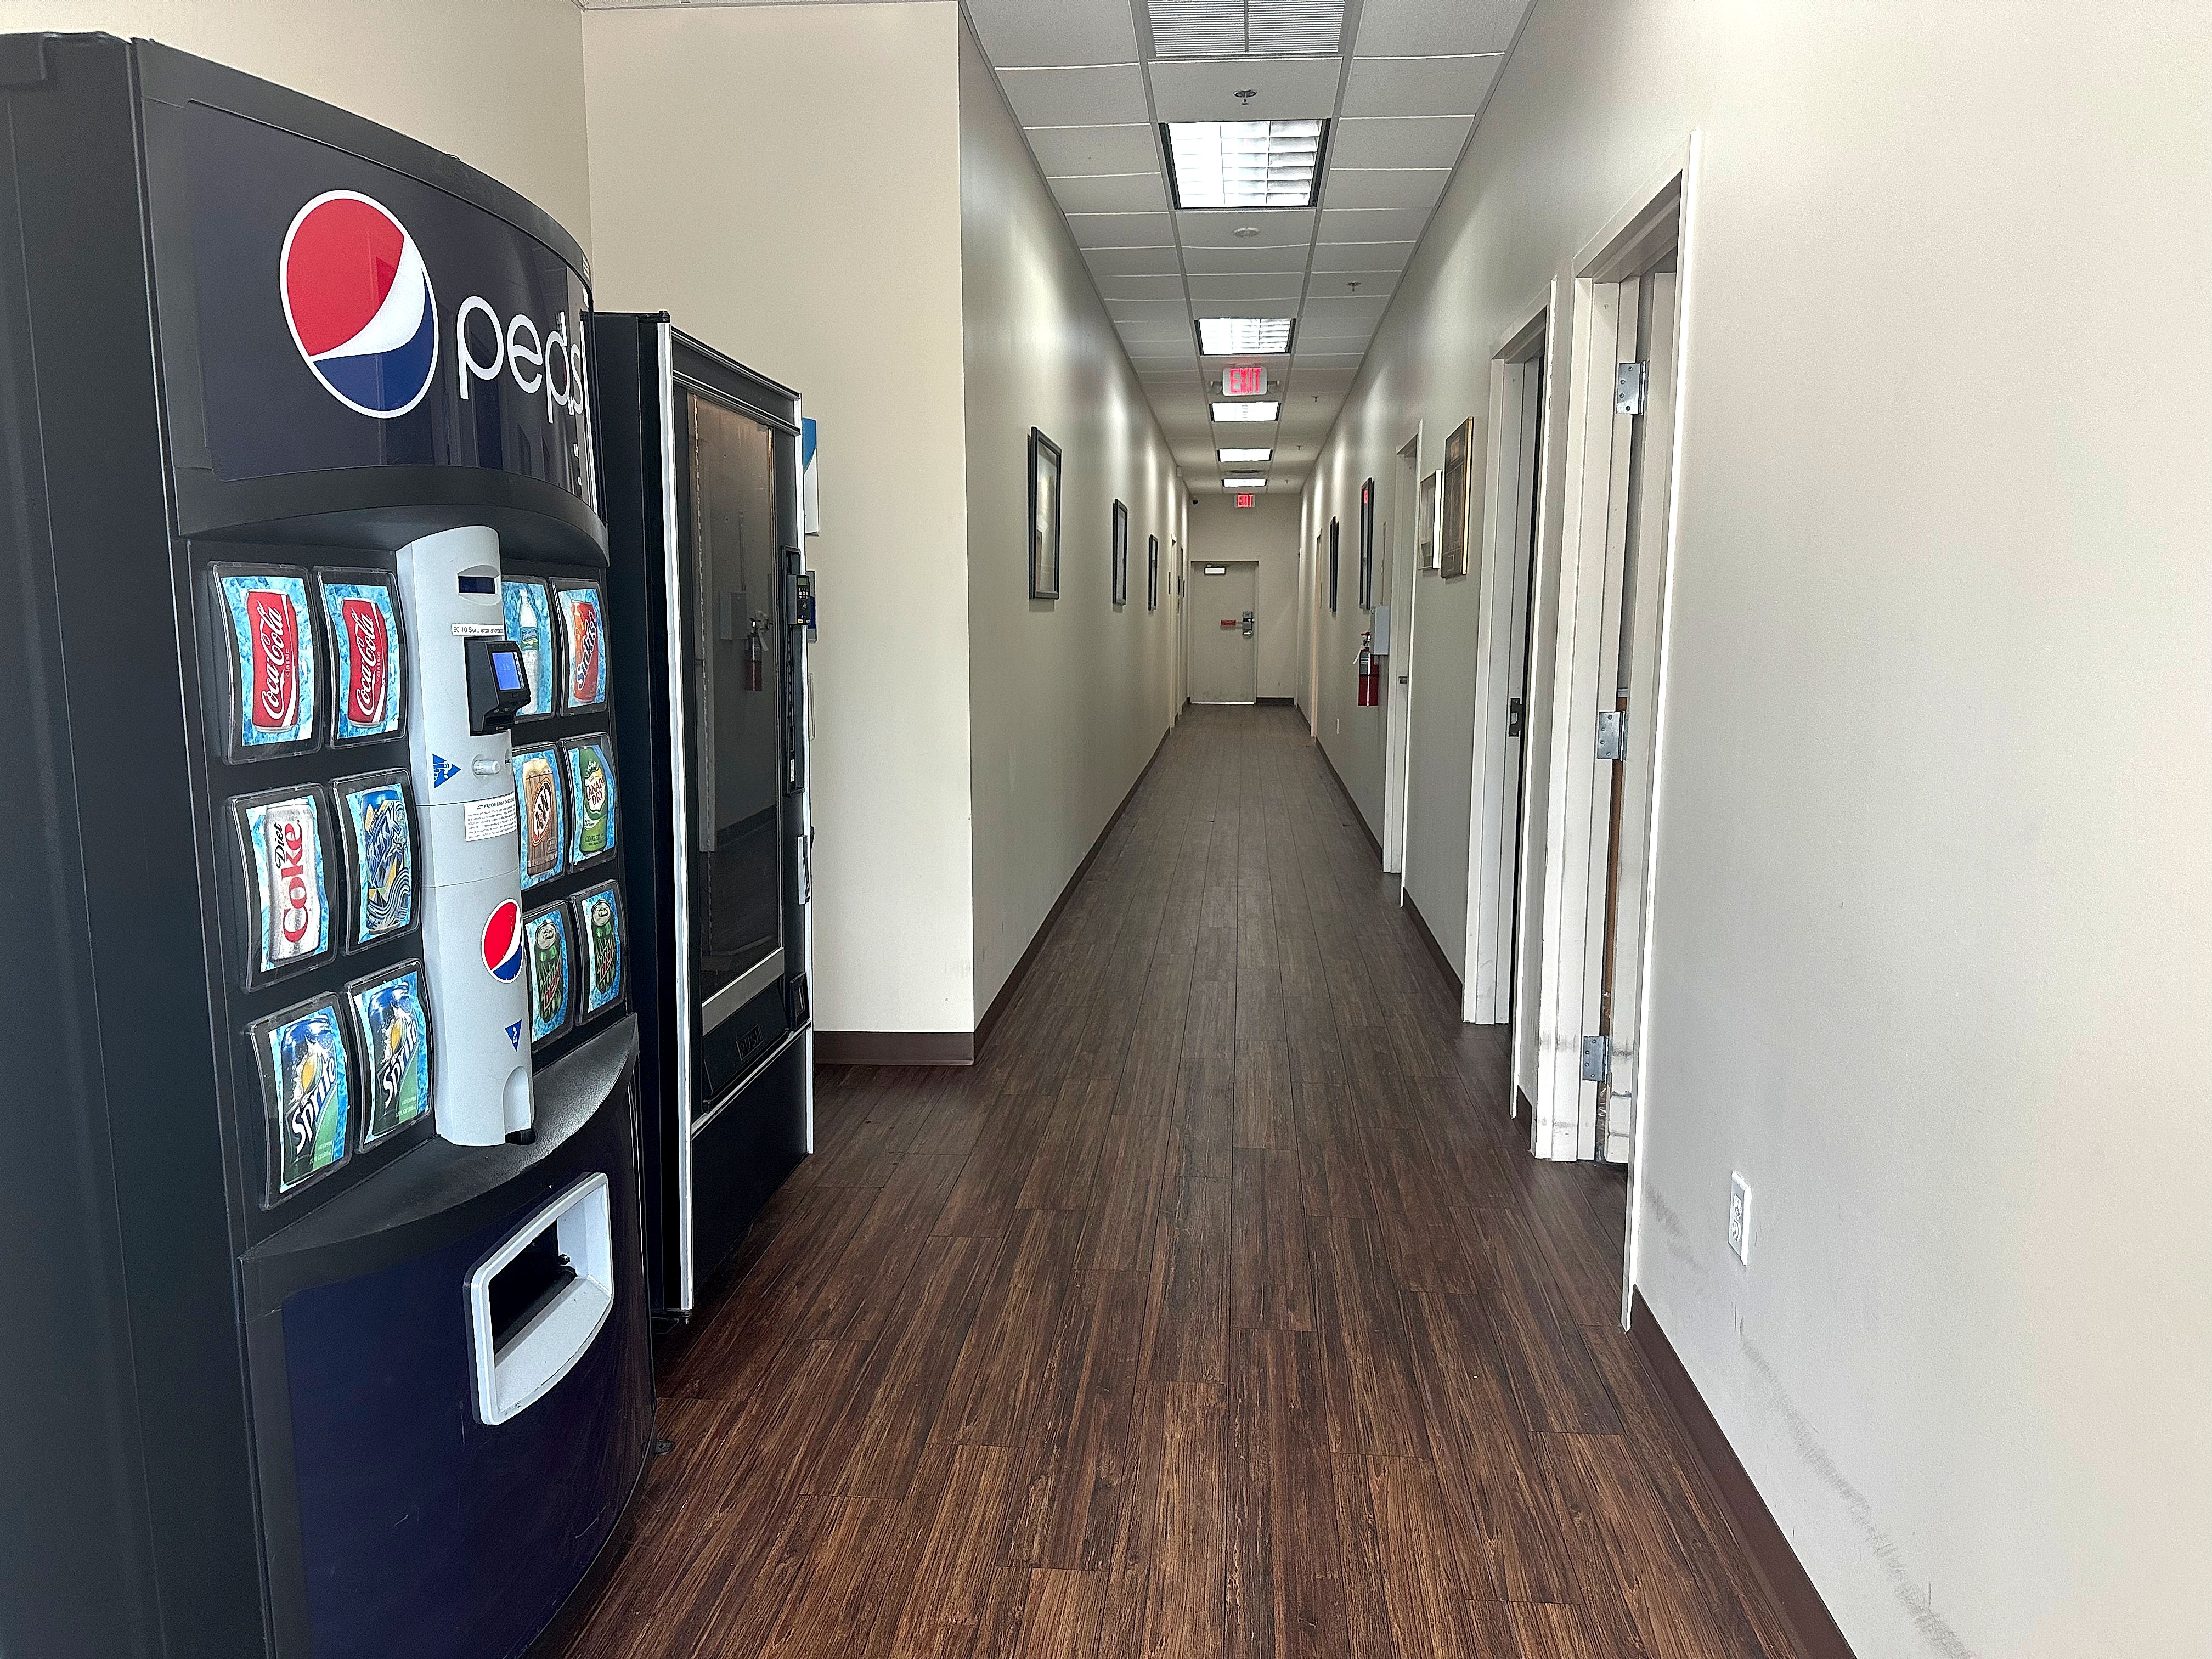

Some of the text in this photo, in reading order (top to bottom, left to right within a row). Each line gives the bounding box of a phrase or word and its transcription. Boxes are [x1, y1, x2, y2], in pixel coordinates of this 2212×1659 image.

[456, 296, 584, 423] peps
[1229, 367, 1262, 394] EXIT
[1237, 494, 1254, 508] EXIT
[577, 610, 596, 691] Sunkist
[592, 789, 603, 806] DRY
[274, 822, 285, 869] Diet
[281, 823, 308, 943] Coke
[383, 1018, 417, 1109] Sprite
[292, 1054, 336, 1155] Sprite
